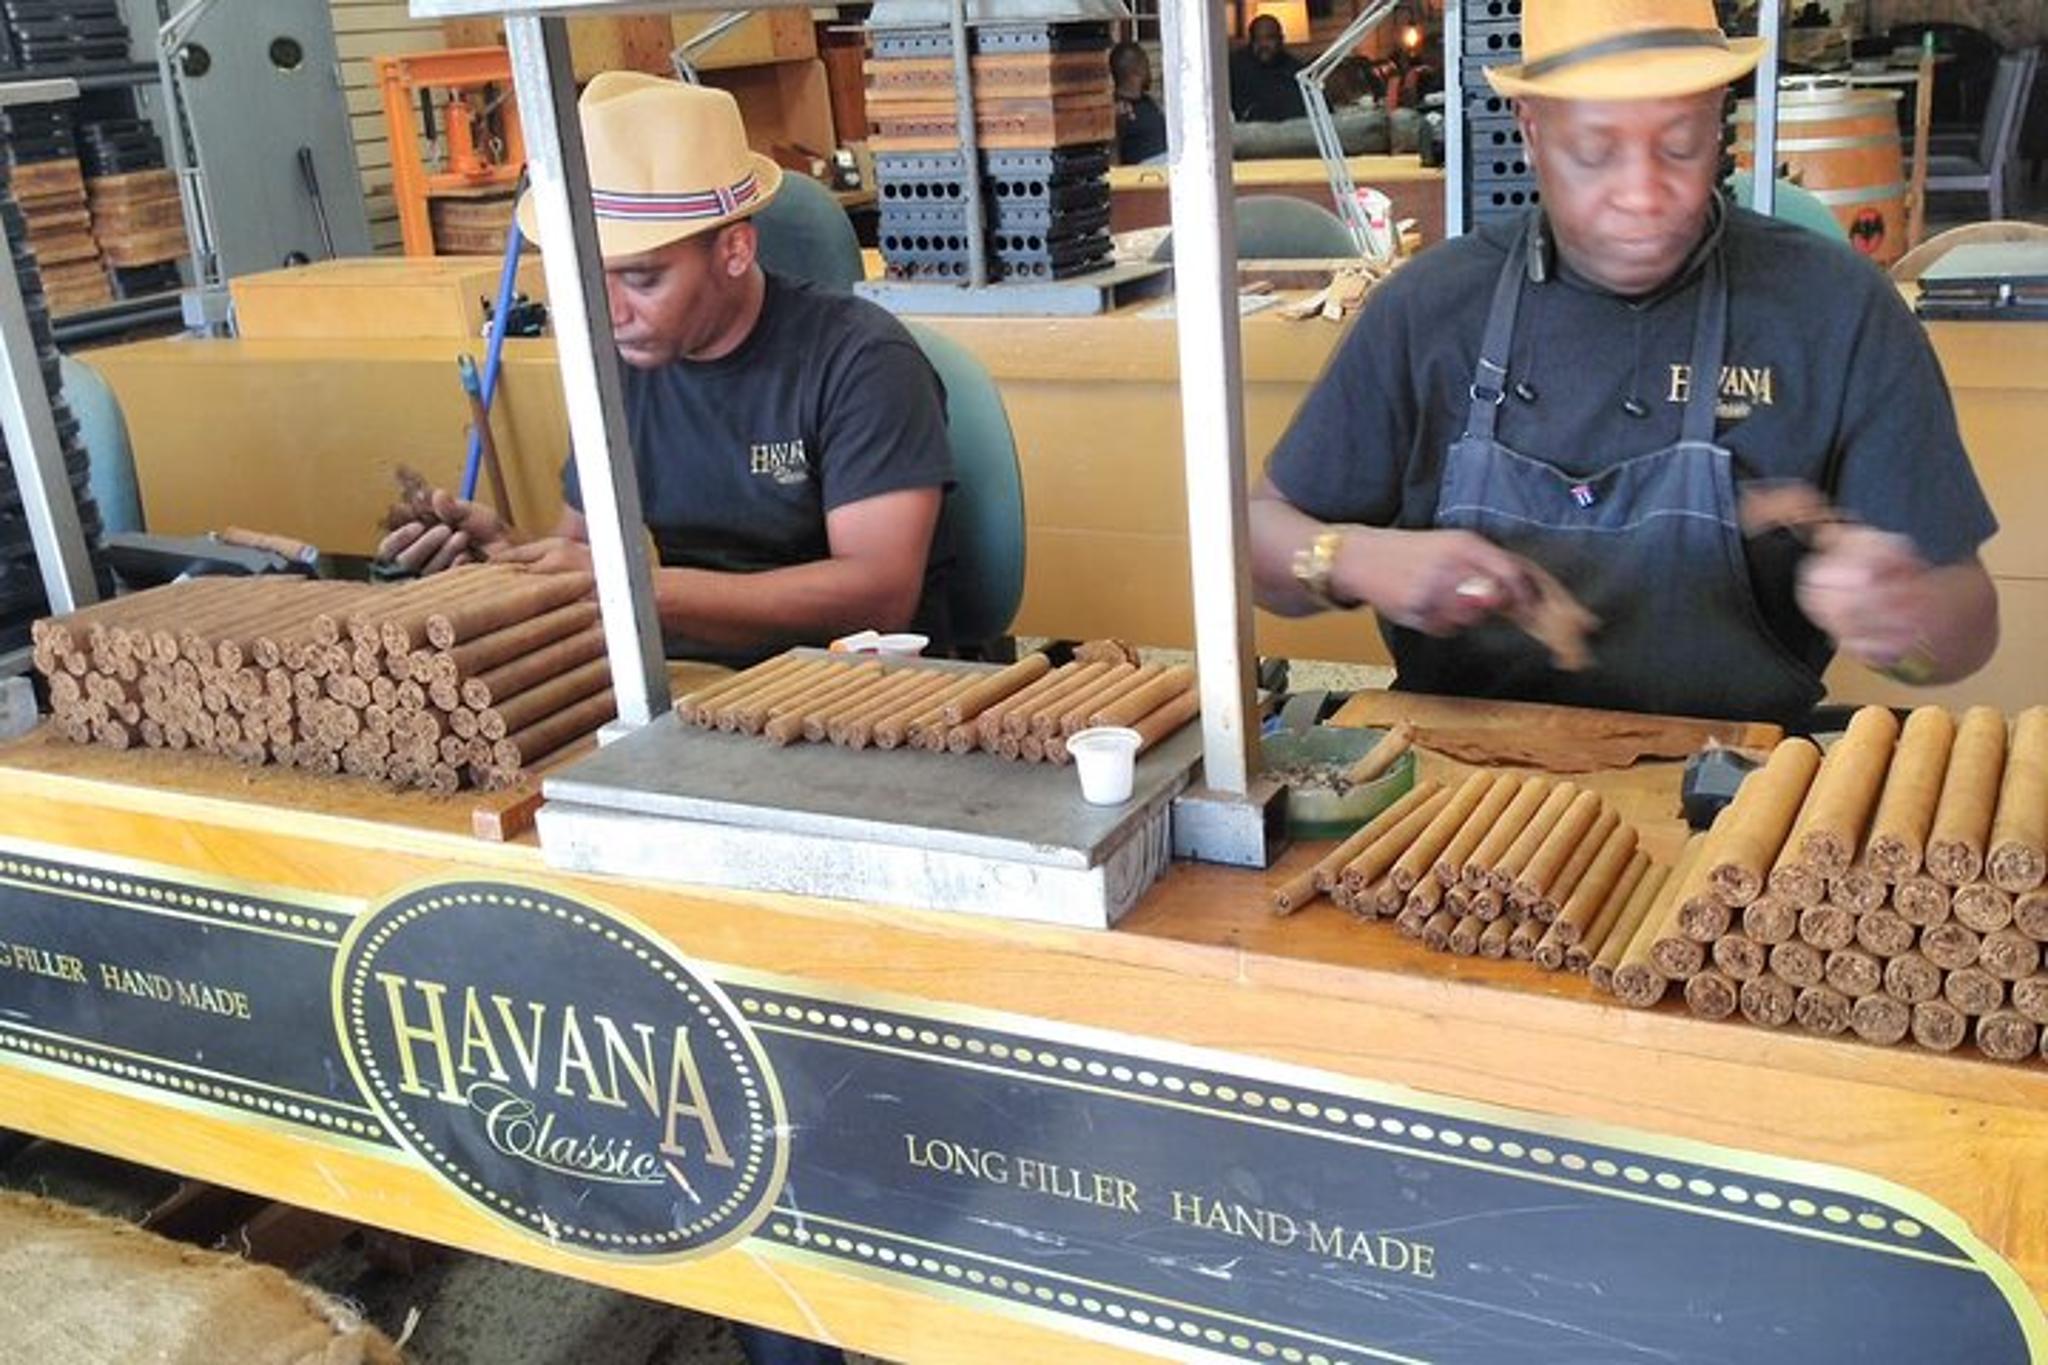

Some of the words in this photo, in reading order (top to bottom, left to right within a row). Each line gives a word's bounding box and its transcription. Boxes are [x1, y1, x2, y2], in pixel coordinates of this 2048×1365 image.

[12, 945, 87, 983] FILLER
[100, 963, 172, 1001] HAND
[176, 980, 251, 1019] MADE
[375, 972, 735, 1168] HAVANA
[466, 1082, 666, 1184] Classic
[904, 1134, 1008, 1184] LONG
[1018, 1157, 1141, 1213] FILLER
[1171, 1191, 1297, 1246] HAND
[1306, 1220, 1436, 1279] MADE
